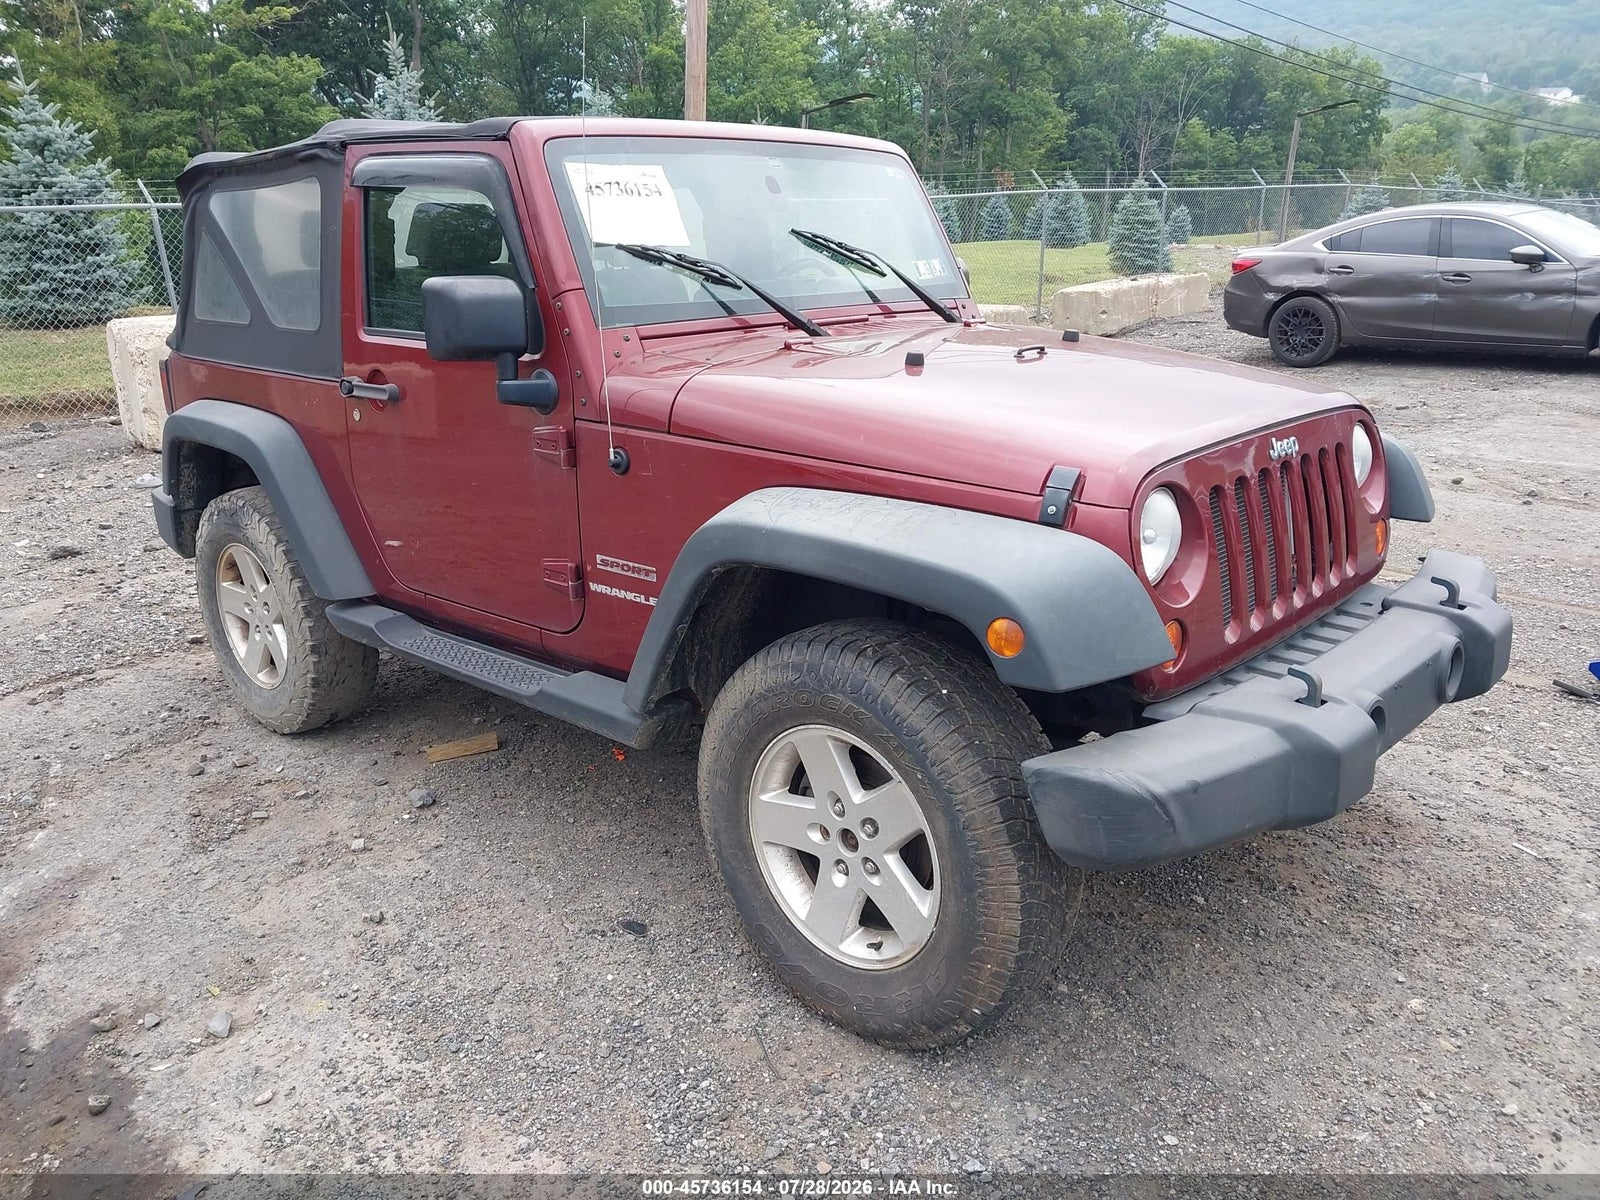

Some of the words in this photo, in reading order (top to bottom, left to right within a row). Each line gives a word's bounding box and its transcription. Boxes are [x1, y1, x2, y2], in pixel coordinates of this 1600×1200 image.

[585, 180, 663, 198] 45736154
[1269, 436, 1299, 460] Jeep
[597, 558, 656, 577] SPORT
[588, 582, 658, 606] WRANGLE
